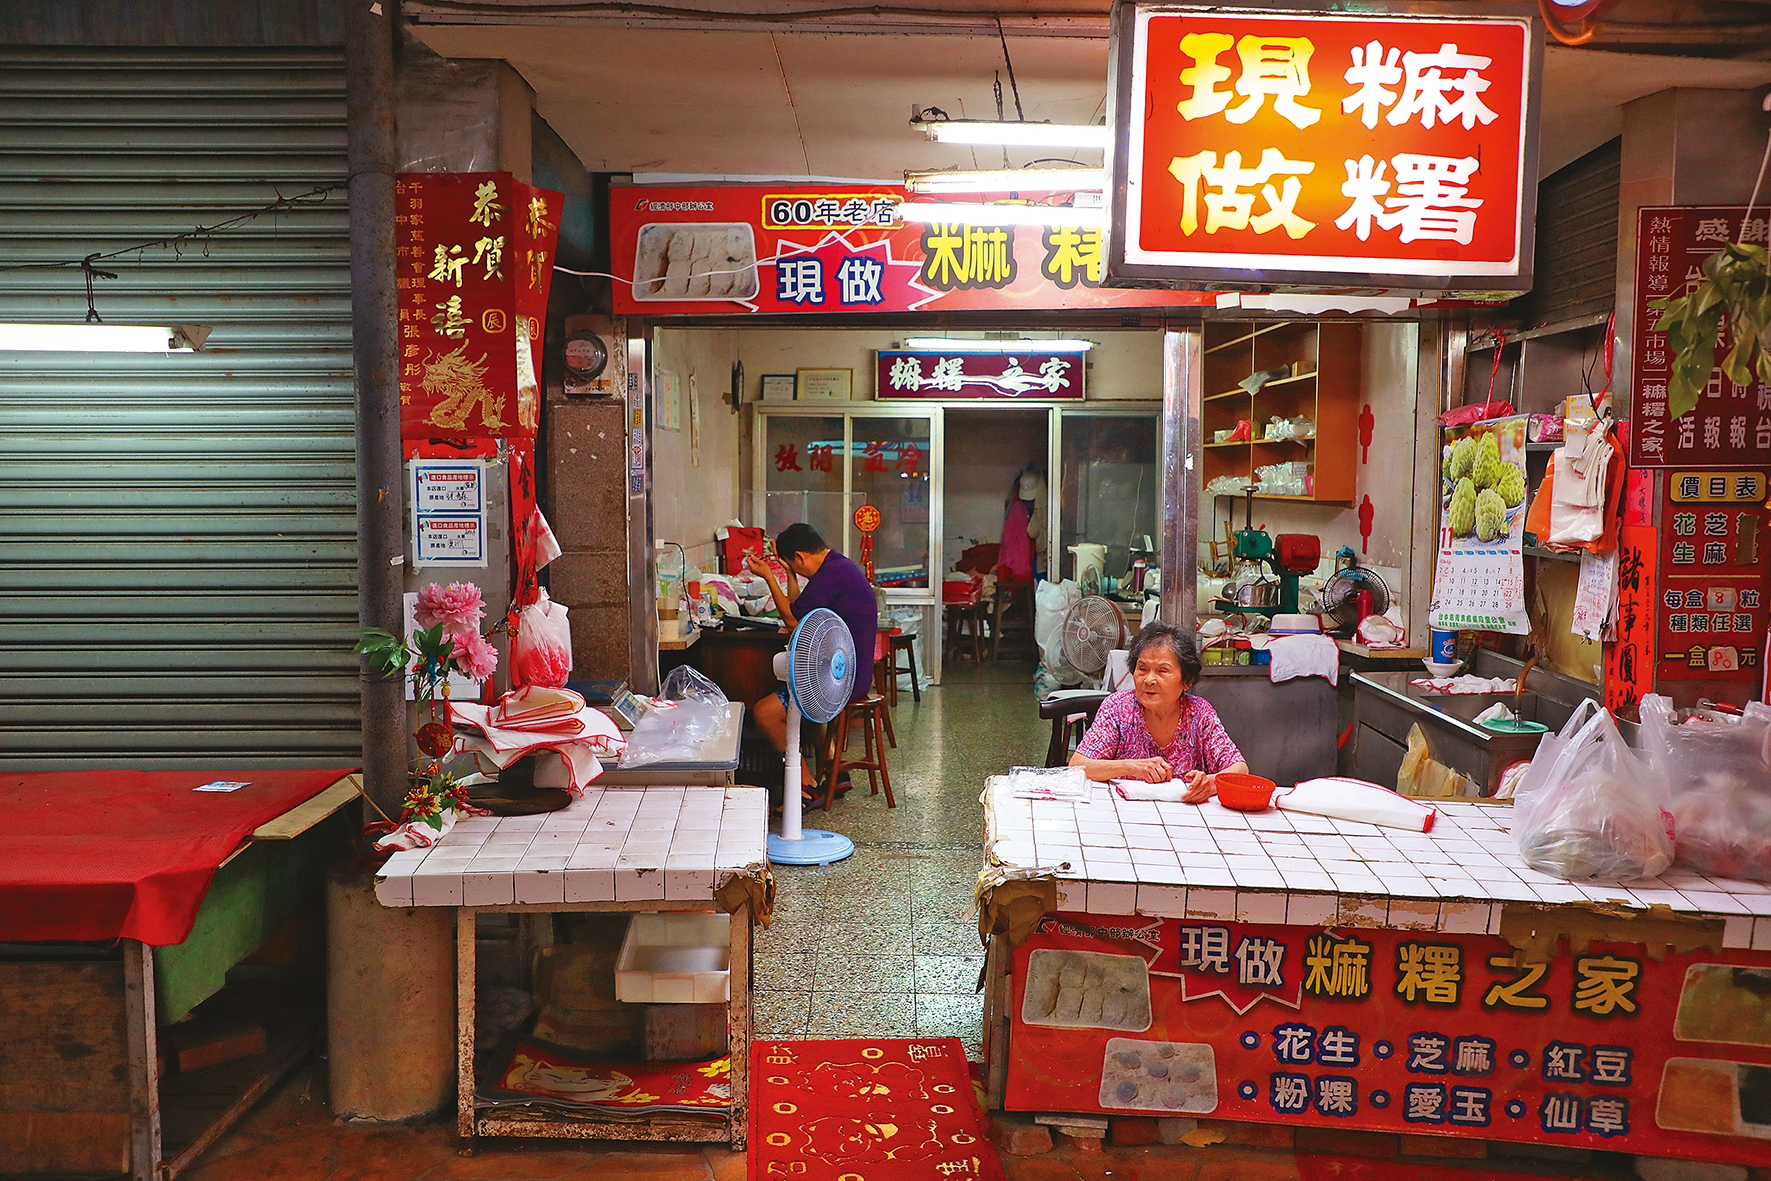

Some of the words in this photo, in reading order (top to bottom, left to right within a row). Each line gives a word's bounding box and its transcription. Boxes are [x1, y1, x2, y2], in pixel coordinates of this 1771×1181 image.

[1168, 32, 1322, 239] 現做
[771, 198, 895, 226] 60年老店
[777, 256, 885, 305] 現做
[486, 313, 502, 329] 辰
[1679, 475, 1757, 498] 價目表
[1441, 526, 1454, 548] 11
[1664, 589, 1704, 609] 每盒
[1715, 591, 1725, 604] 8
[1740, 589, 1759, 609] 粒
[1669, 614, 1753, 633] 種類任選
[1664, 645, 1706, 666] 一盒
[1712, 651, 1732, 669] 80
[1740, 646, 1756, 666] 元
[1180, 924, 1286, 987] 現做
[1275, 1026, 1356, 1064] 花生
[1410, 1036, 1492, 1074] 芝麻
[1545, 1044, 1630, 1083] 紅豆
[1273, 1076, 1354, 1113] 粉粿
[1407, 1086, 1488, 1123] 愛玉
[1543, 1096, 1625, 1133] 仙草
